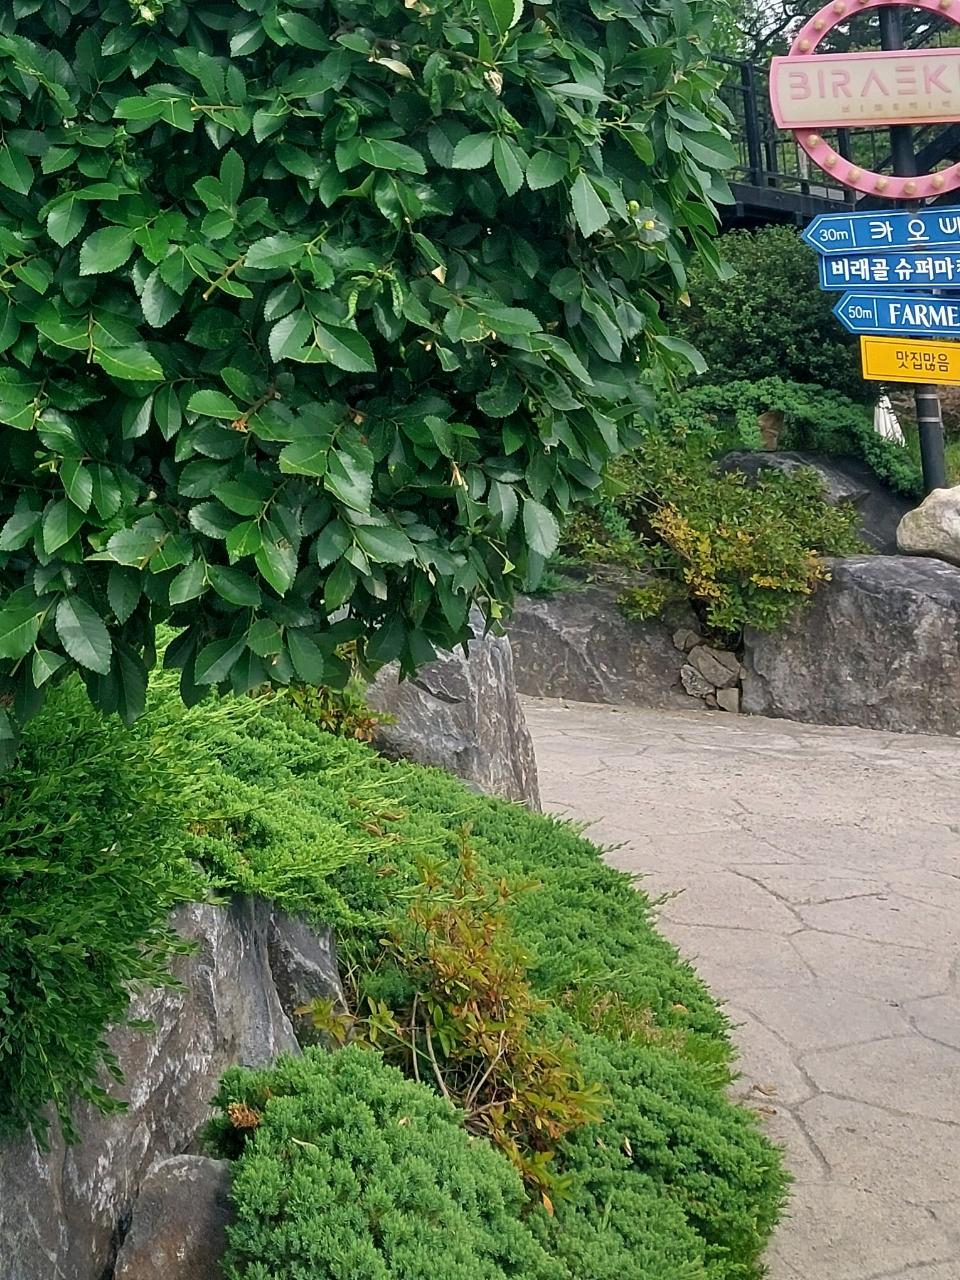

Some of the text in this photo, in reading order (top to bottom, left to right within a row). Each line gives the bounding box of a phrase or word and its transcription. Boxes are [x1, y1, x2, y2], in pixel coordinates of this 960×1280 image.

[790, 64, 960, 100] BIRAEK
[819, 229, 848, 241] 30m
[831, 257, 960, 281] 비래골 슈퍼마
[848, 306, 872, 319] 50m
[896, 350, 950, 372] 맛집많음
